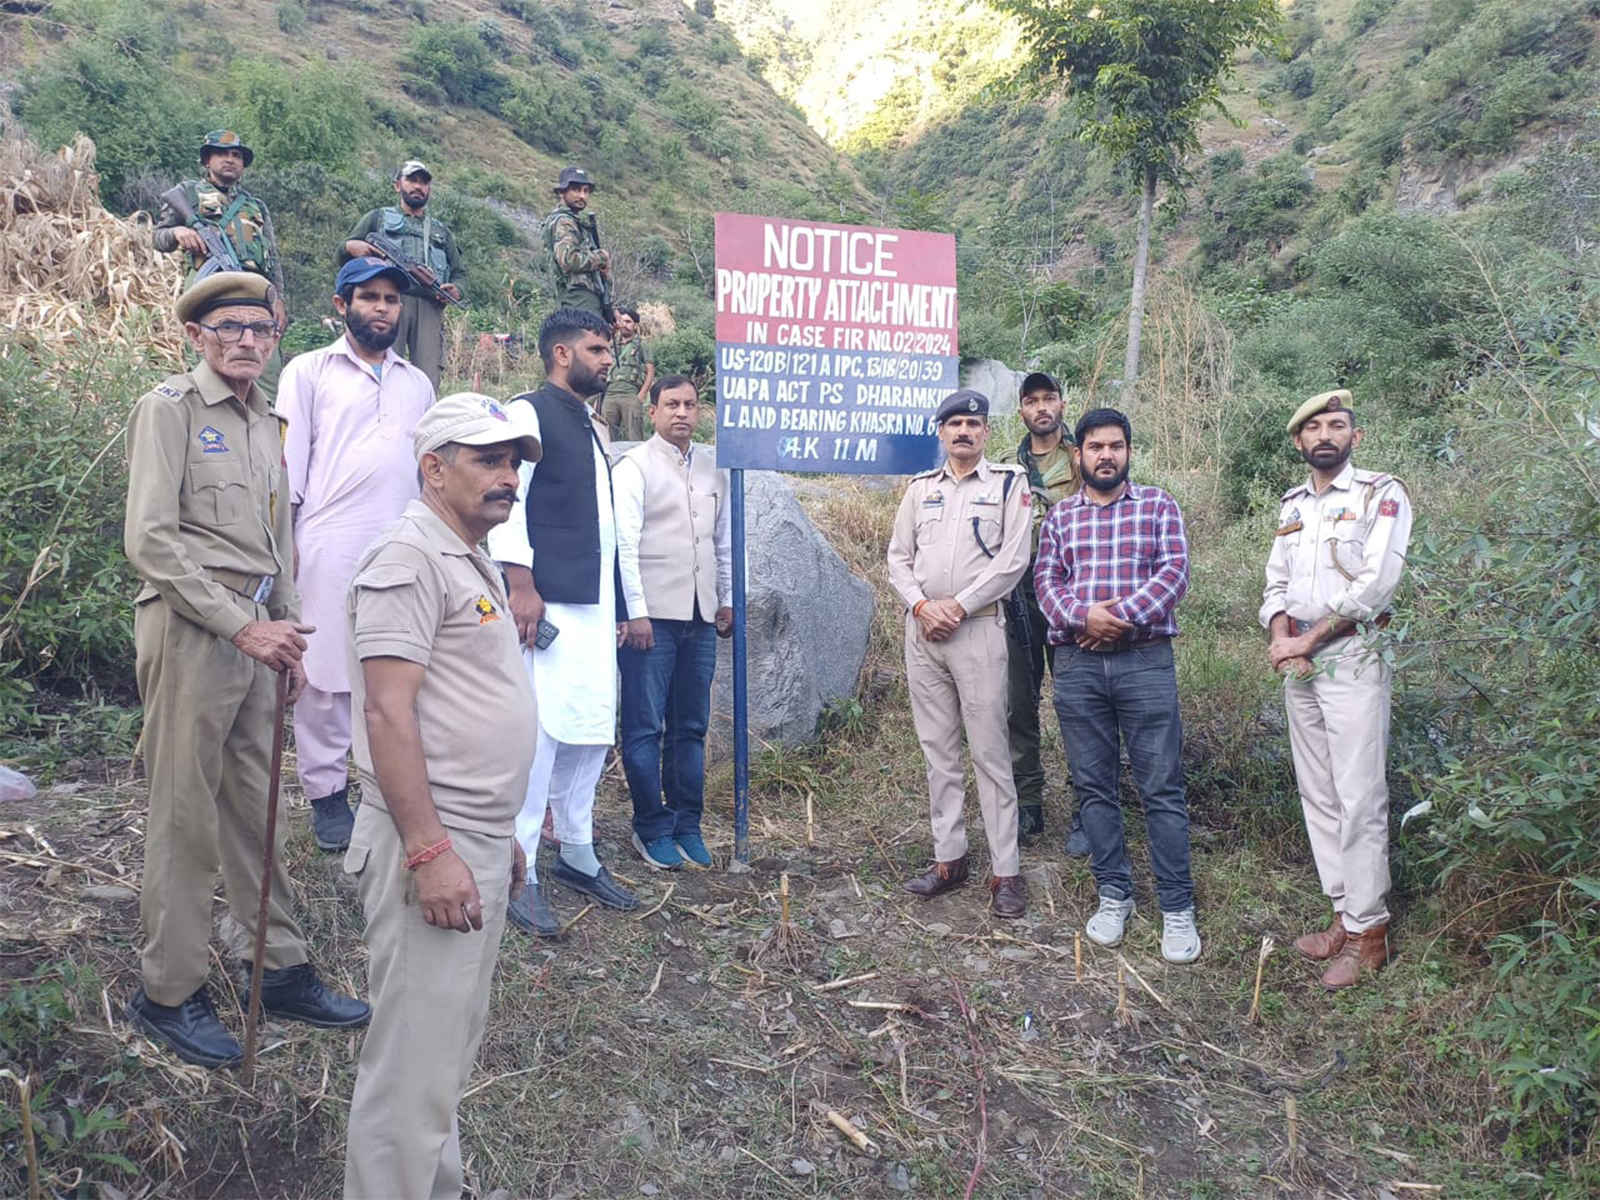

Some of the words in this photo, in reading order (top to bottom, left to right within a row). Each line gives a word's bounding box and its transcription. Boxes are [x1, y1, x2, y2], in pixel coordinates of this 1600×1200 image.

[764, 224, 898, 277] NOTICE
[717, 269, 822, 320] PROPERTY
[824, 278, 956, 329] ATTACHMENT
[746, 321, 768, 344] IN
[777, 324, 826, 348] CASE
[833, 327, 864, 351] FIR
[723, 376, 769, 401] UAPA
[776, 380, 811, 403] ACT
[819, 382, 844, 405] PS
[723, 404, 776, 429] LAND
[780, 408, 847, 432] BEARING
[849, 411, 903, 435] KHASRA
